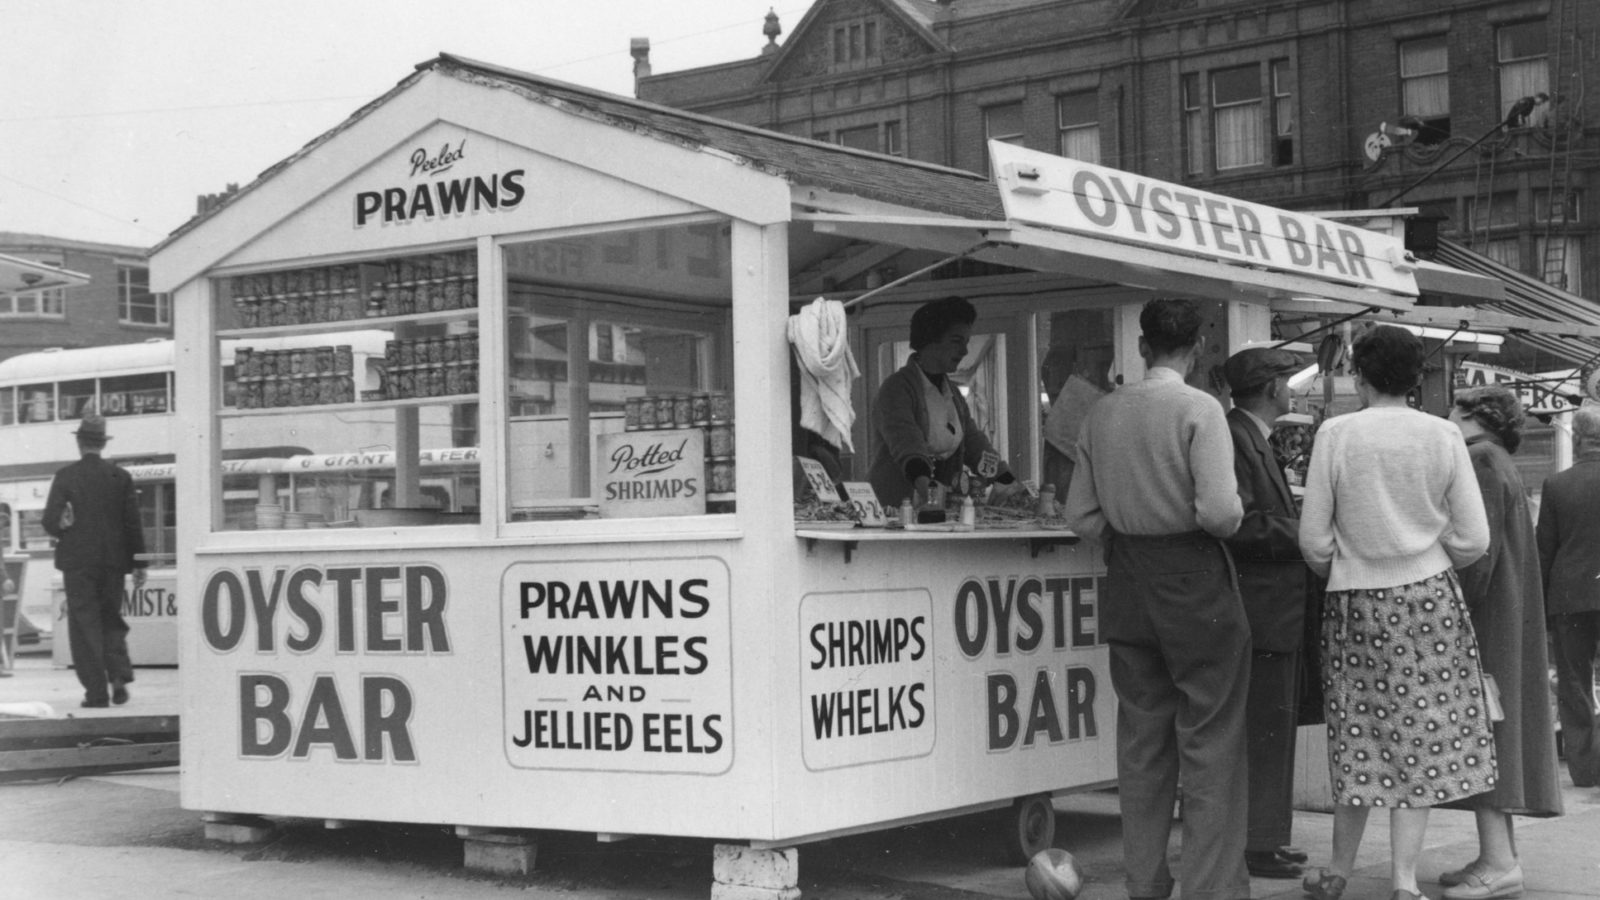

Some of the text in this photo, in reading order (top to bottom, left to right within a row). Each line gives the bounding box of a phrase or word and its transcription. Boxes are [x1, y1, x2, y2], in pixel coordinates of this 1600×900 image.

[410, 139, 466, 177] Peeled
[355, 169, 525, 228] PRAWNS
[1071, 169, 1374, 280] OYSTER BAR
[324, 453, 390, 467] GIANT
[608, 438, 688, 475] Potted
[605, 478, 697, 500] SHRIMPS
[202, 564, 451, 653] OYSTER
[520, 578, 710, 619] PRAWNS
[954, 574, 1108, 658] OYSTE
[523, 635, 709, 675] WINKLES
[809, 616, 926, 670] SHRIMPS
[582, 685, 647, 702] AND
[810, 682, 926, 740] WHELKS
[987, 664, 1098, 751] BAR
[240, 674, 417, 763] BAR
[512, 710, 723, 754] JELLIED EELS
